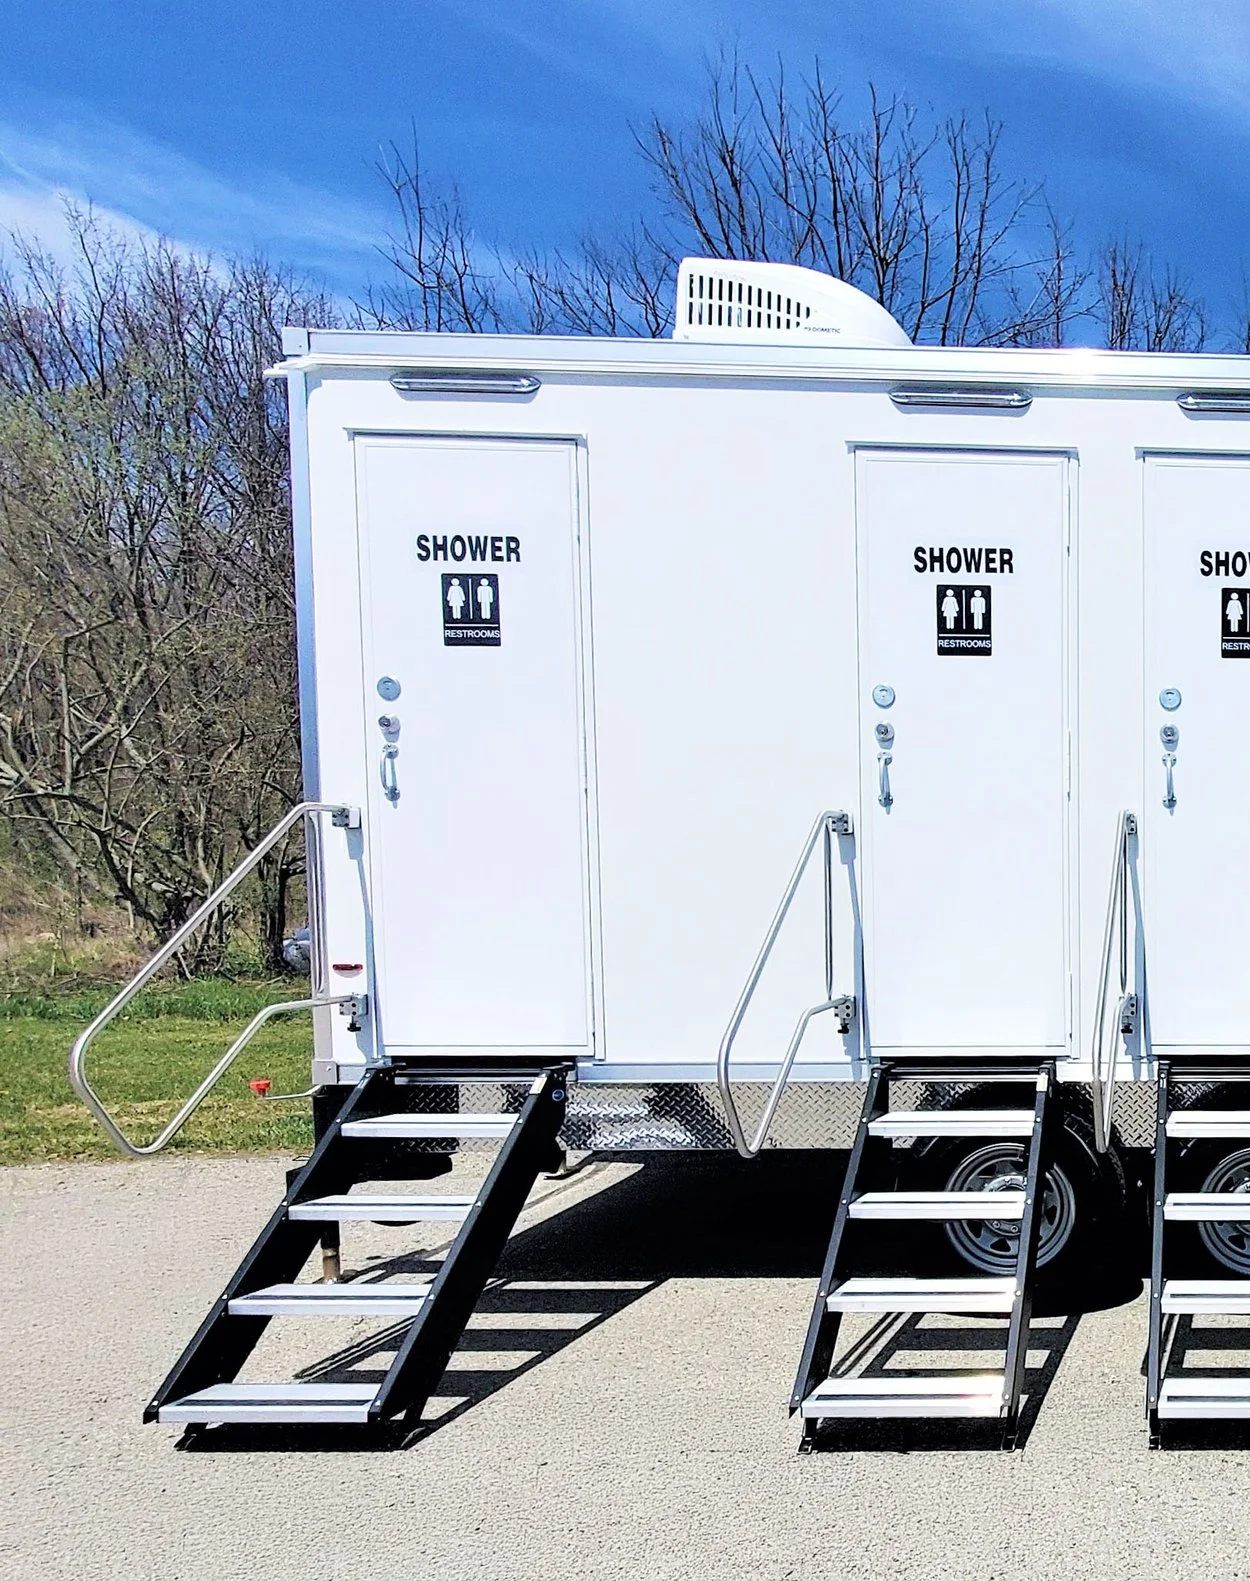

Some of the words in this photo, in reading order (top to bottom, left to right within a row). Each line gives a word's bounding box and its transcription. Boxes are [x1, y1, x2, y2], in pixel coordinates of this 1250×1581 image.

[416, 534, 521, 562] SHOWER
[913, 546, 1014, 574] SHOWER
[444, 629, 500, 639] RESTROOMS
[938, 639, 992, 649] RESTROOMS
